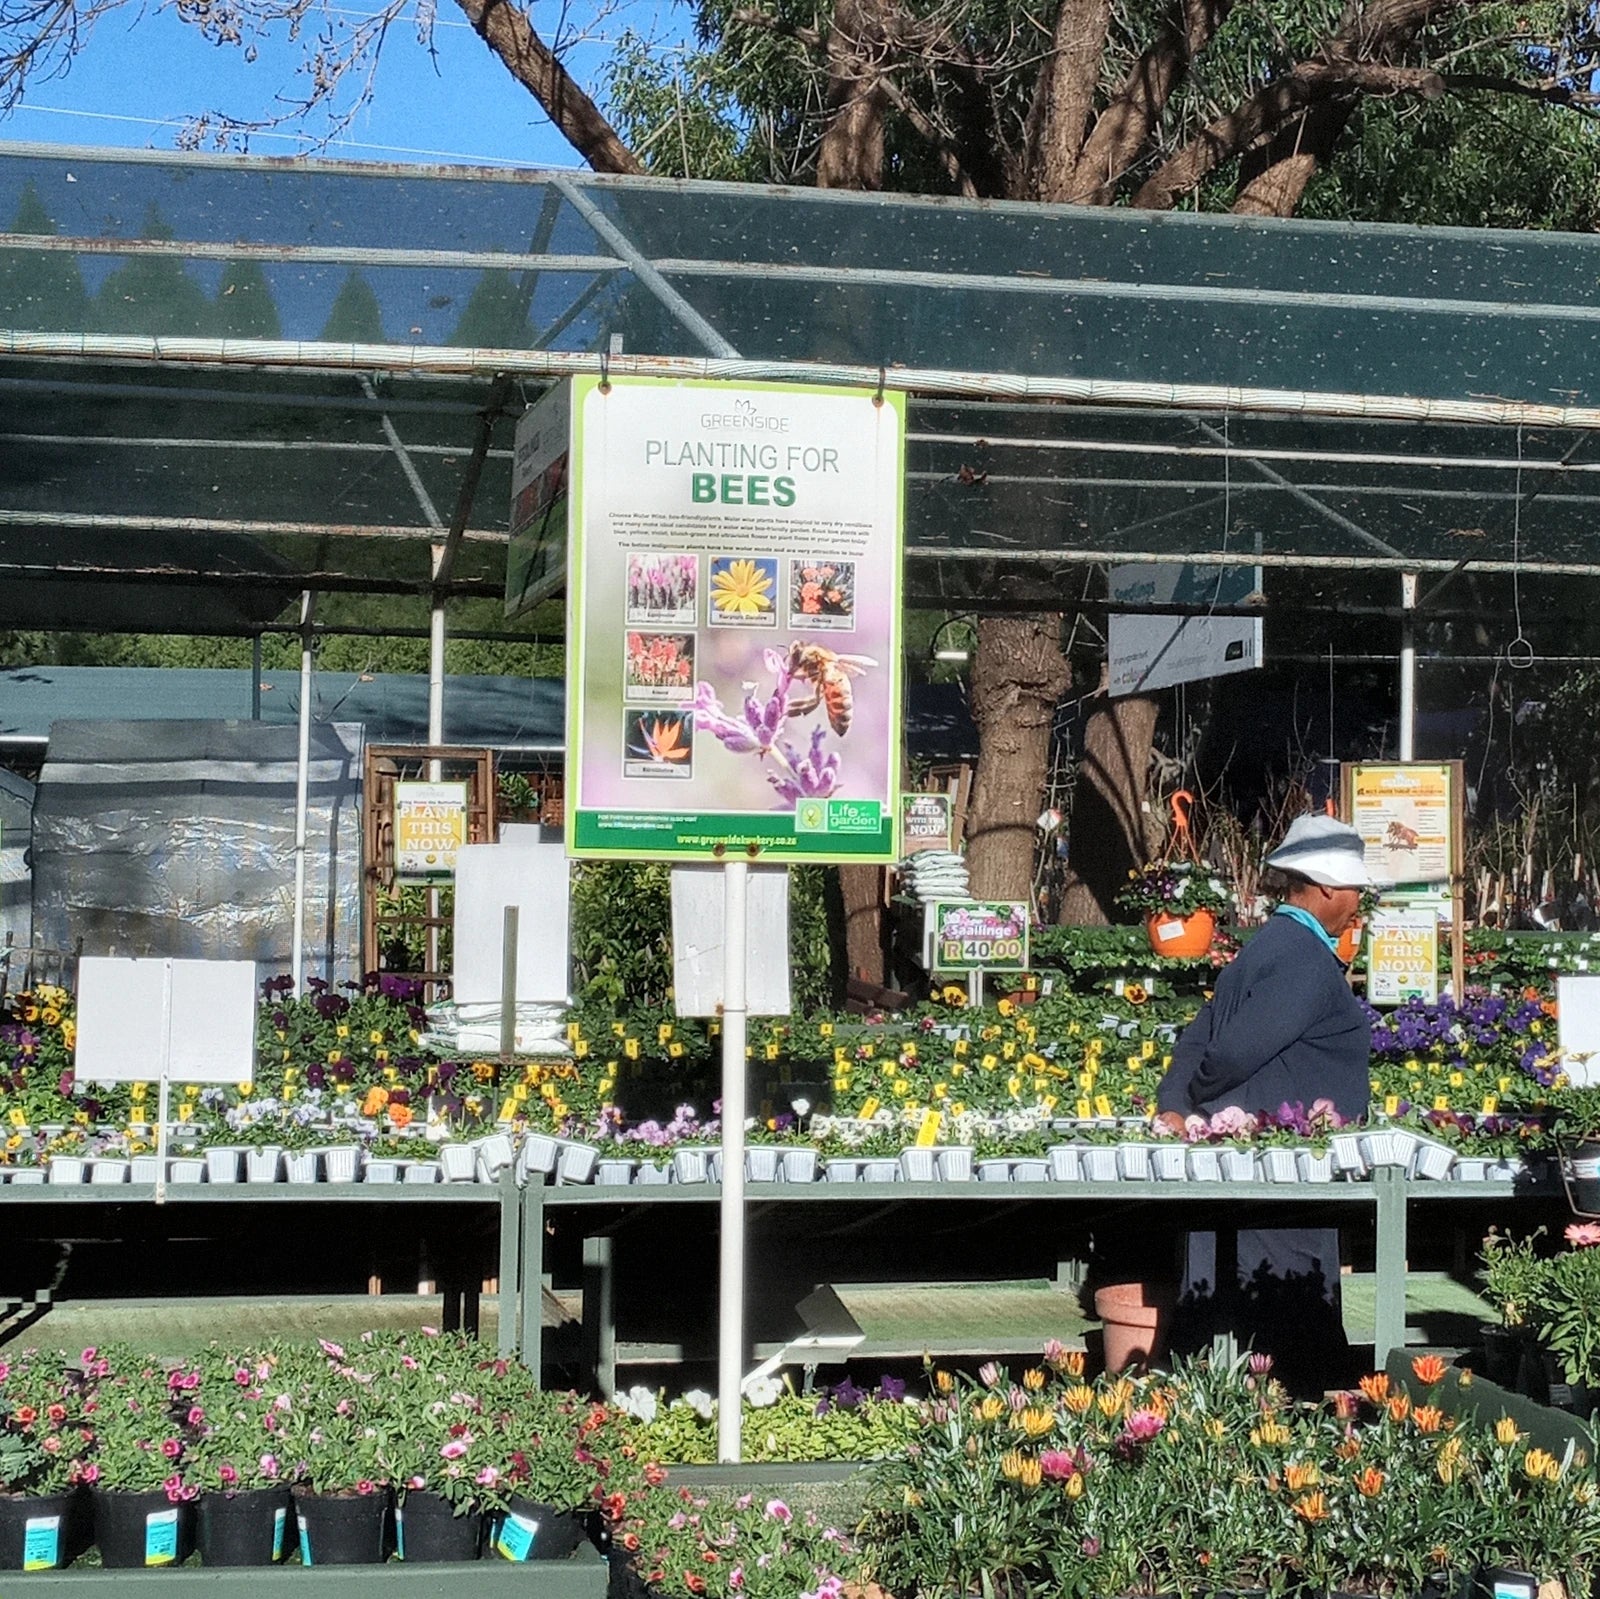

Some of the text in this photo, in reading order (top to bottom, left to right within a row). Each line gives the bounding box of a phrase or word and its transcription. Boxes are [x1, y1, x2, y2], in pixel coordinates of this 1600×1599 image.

[701, 413, 789, 431] GREENSIDE
[646, 440, 839, 473] PLANTING FOR
[692, 473, 796, 507] BEES
[400, 806, 460, 818] PLANT
[830, 804, 858, 817] Life
[911, 805, 940, 815] FEED
[830, 816, 877, 826] garden
[408, 822, 452, 835] THIS
[910, 825, 942, 835] NOW
[406, 838, 455, 850] NOW
[950, 925, 1012, 939] Saailinge
[1374, 930, 1432, 942] PLANT
[1382, 945, 1424, 957] THIS
[1378, 960, 1426, 972] NOW
